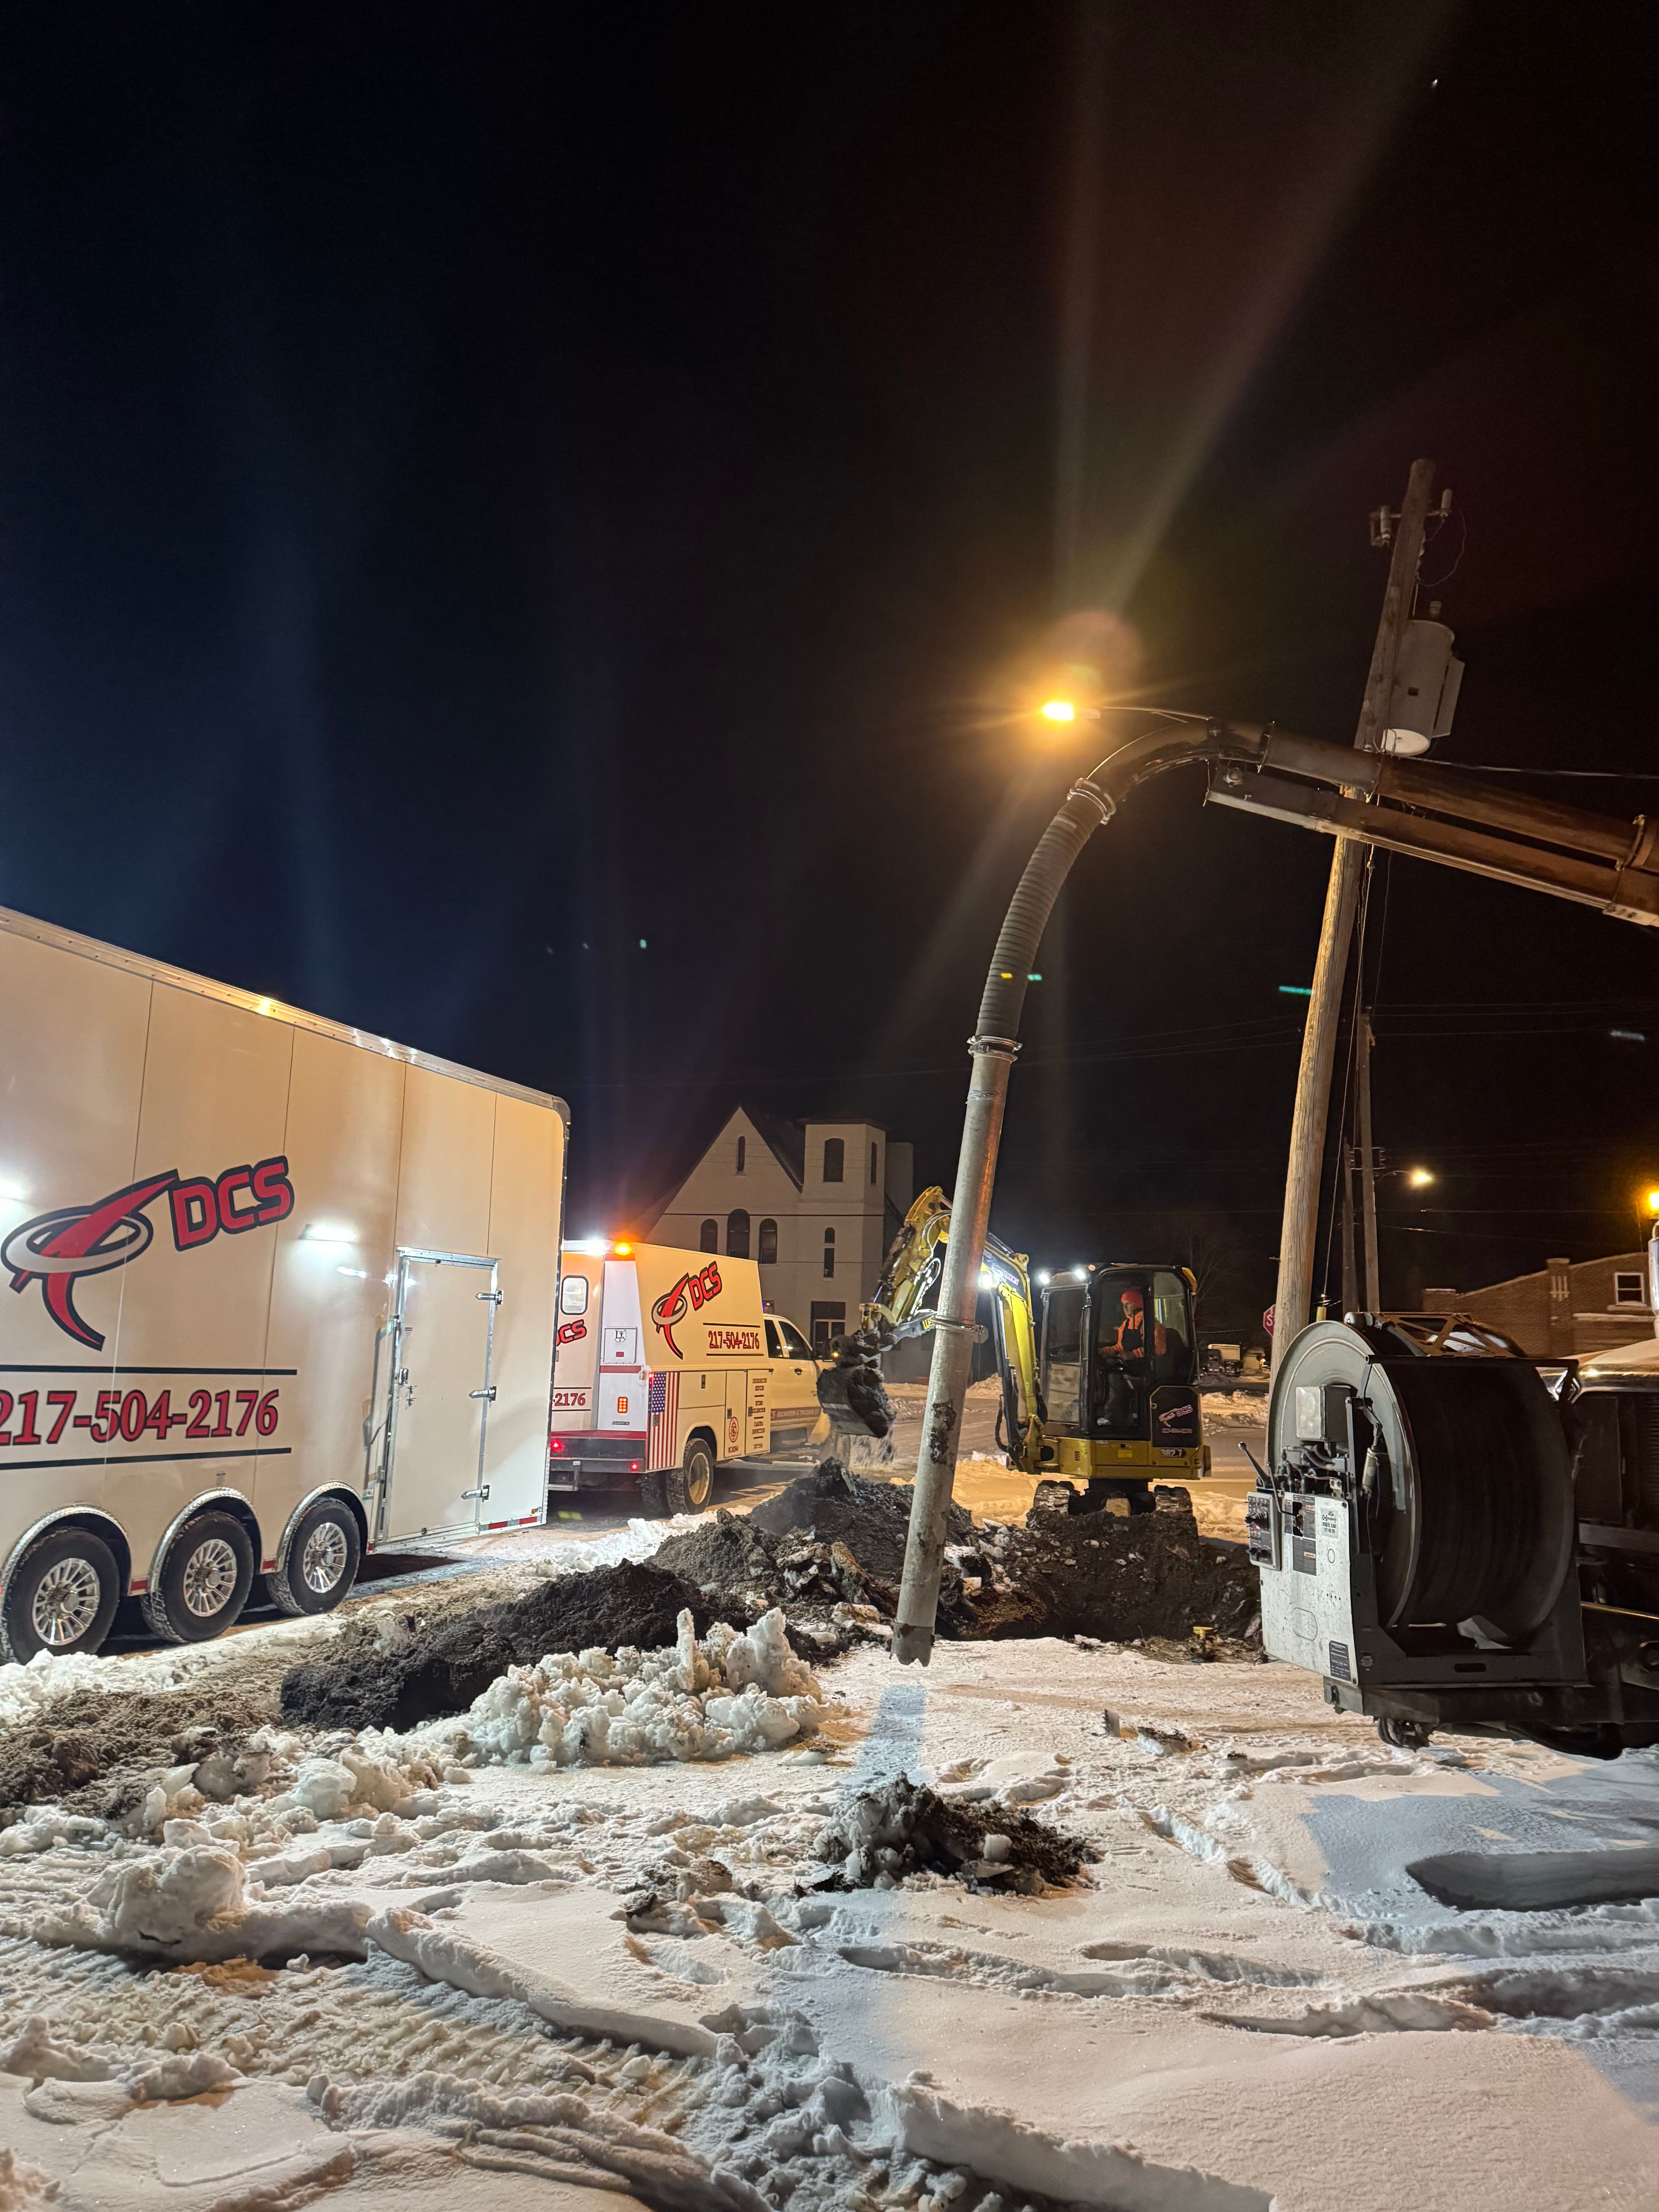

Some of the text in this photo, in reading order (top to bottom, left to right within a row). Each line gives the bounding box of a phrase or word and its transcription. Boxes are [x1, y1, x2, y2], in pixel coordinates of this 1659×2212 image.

[168, 1155, 295, 1251] DCS
[688, 1261, 722, 1311] DCS
[556, 1319, 587, 1347] CS
[709, 1331, 760, 1349] 217-504-2176
